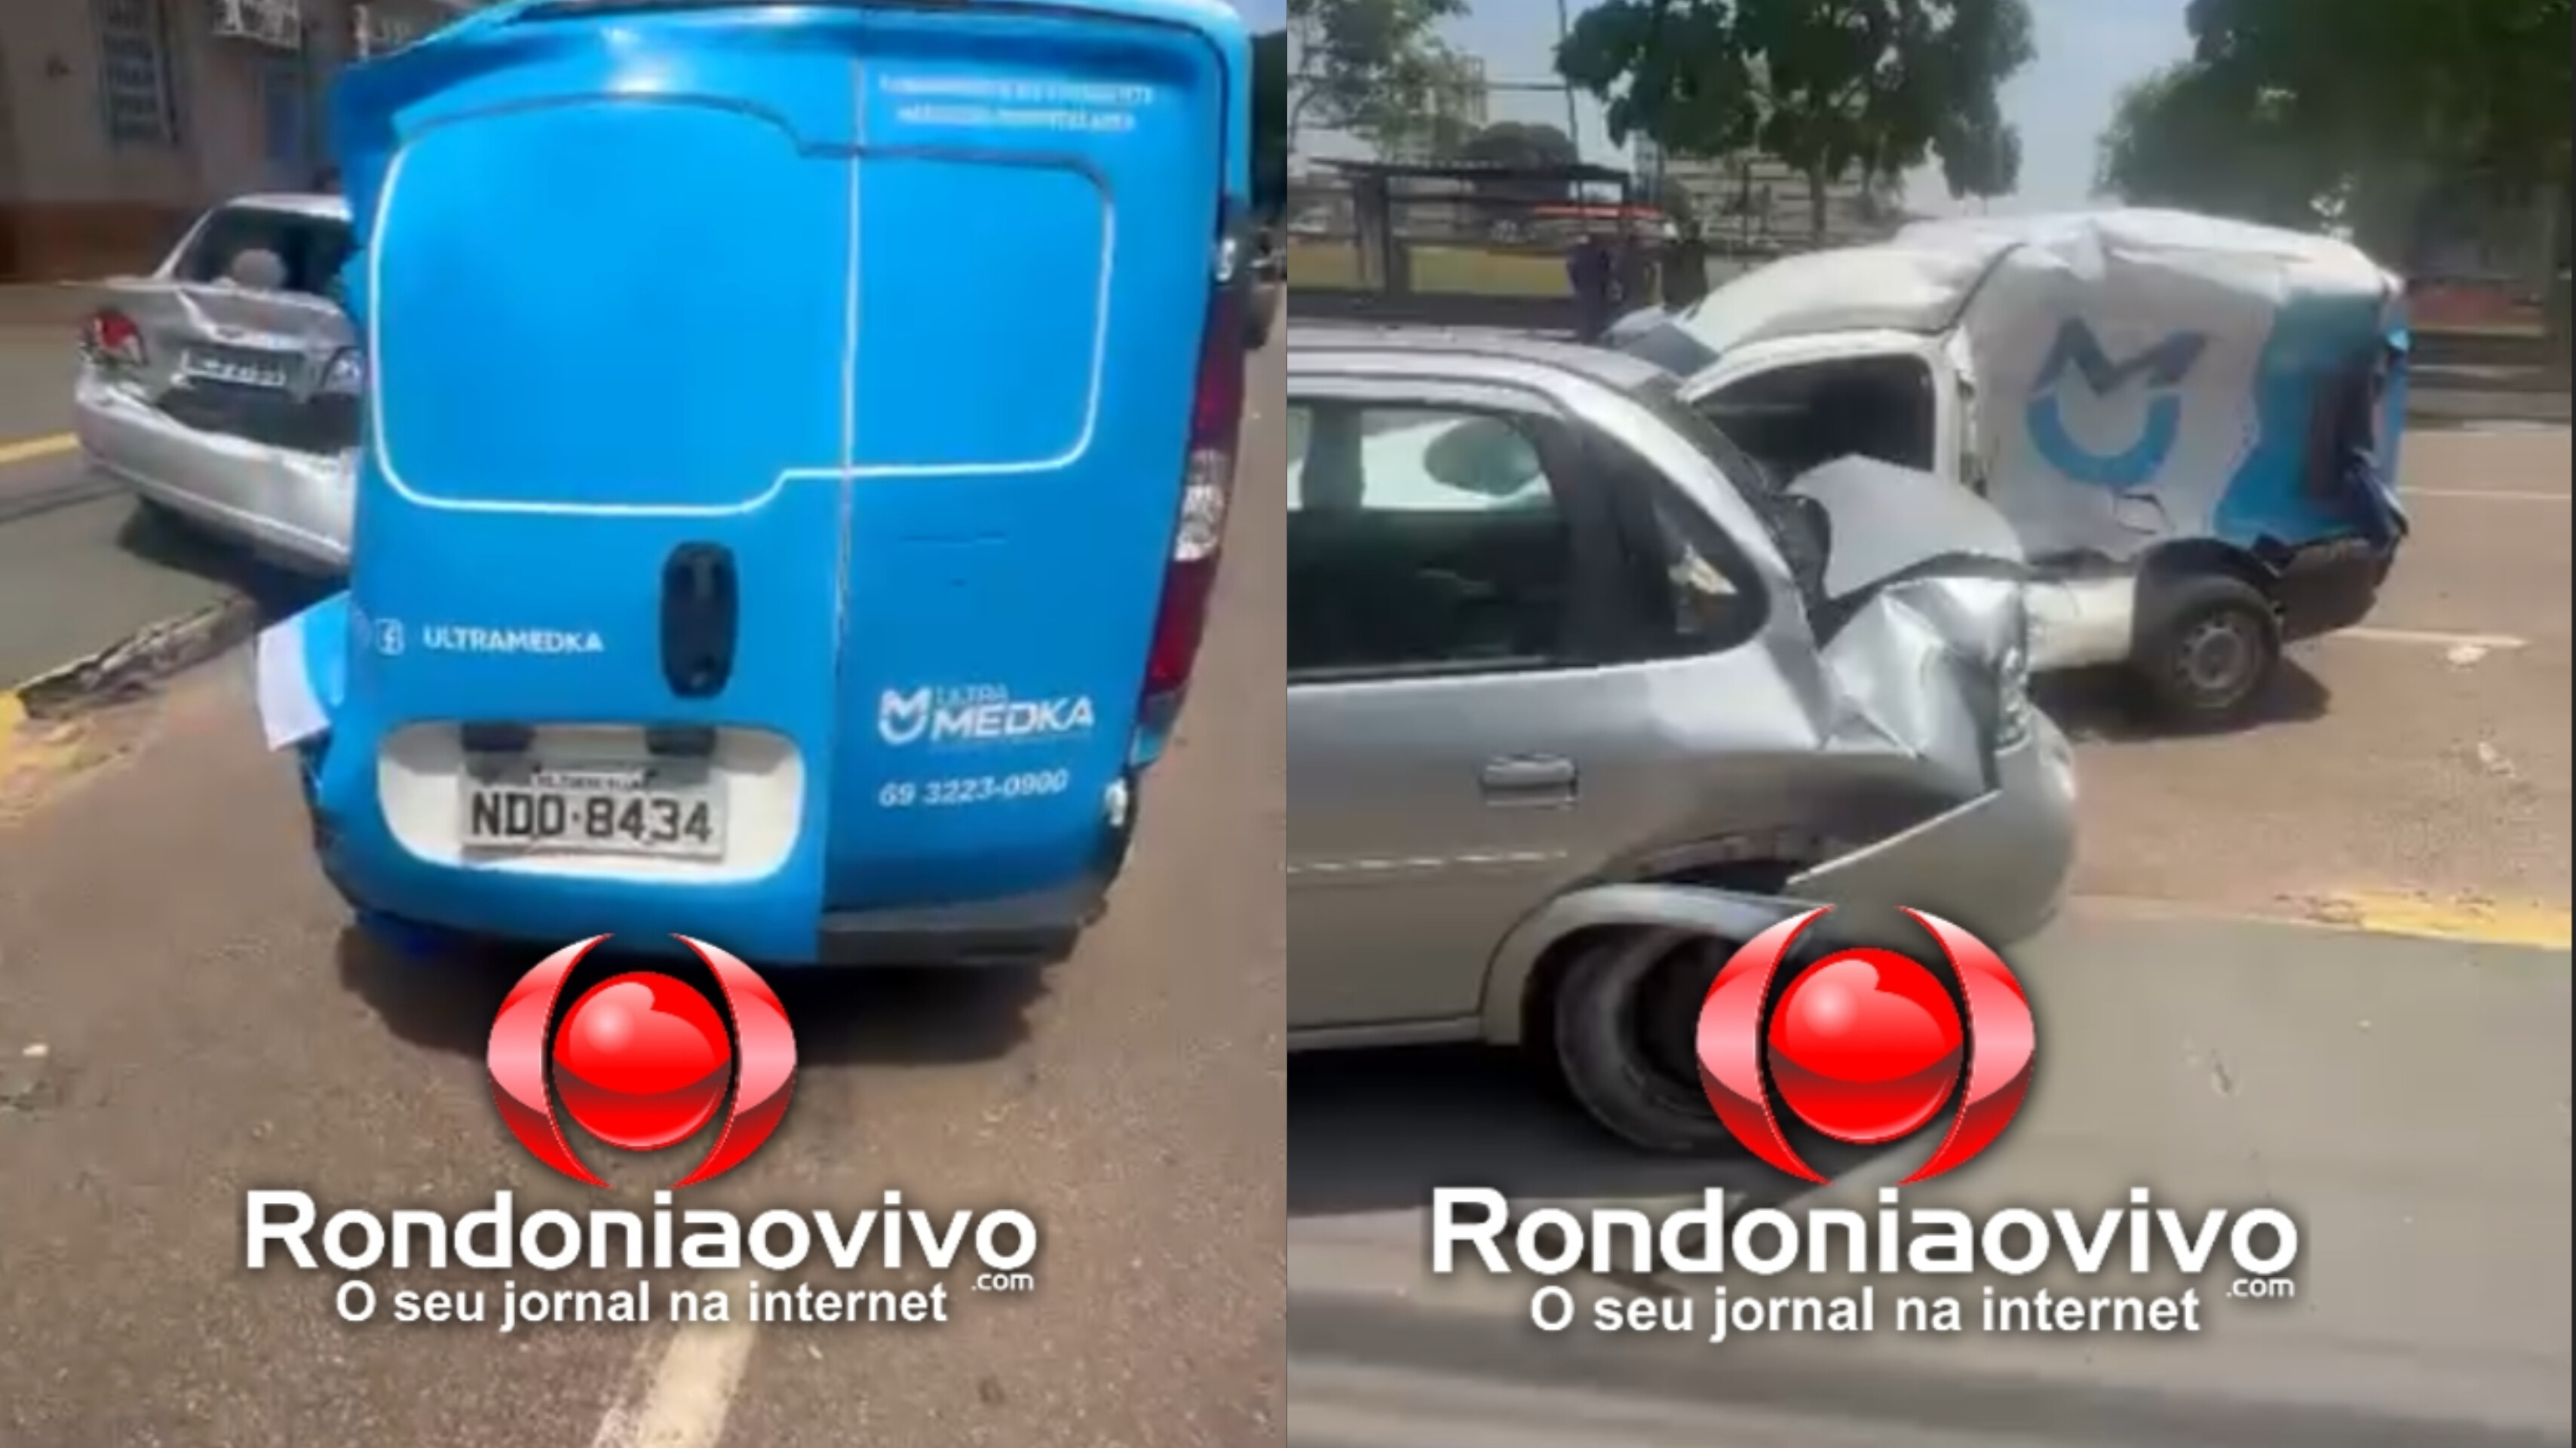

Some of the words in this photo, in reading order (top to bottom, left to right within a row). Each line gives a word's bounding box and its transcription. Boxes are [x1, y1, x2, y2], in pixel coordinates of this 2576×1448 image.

[423, 624, 604, 653] ULTRAMEDKA
[935, 683, 1008, 704] ULTRA
[931, 696, 1094, 741] MEDKA
[879, 781, 915, 807] 69
[922, 768, 1069, 805] 3223-0900
